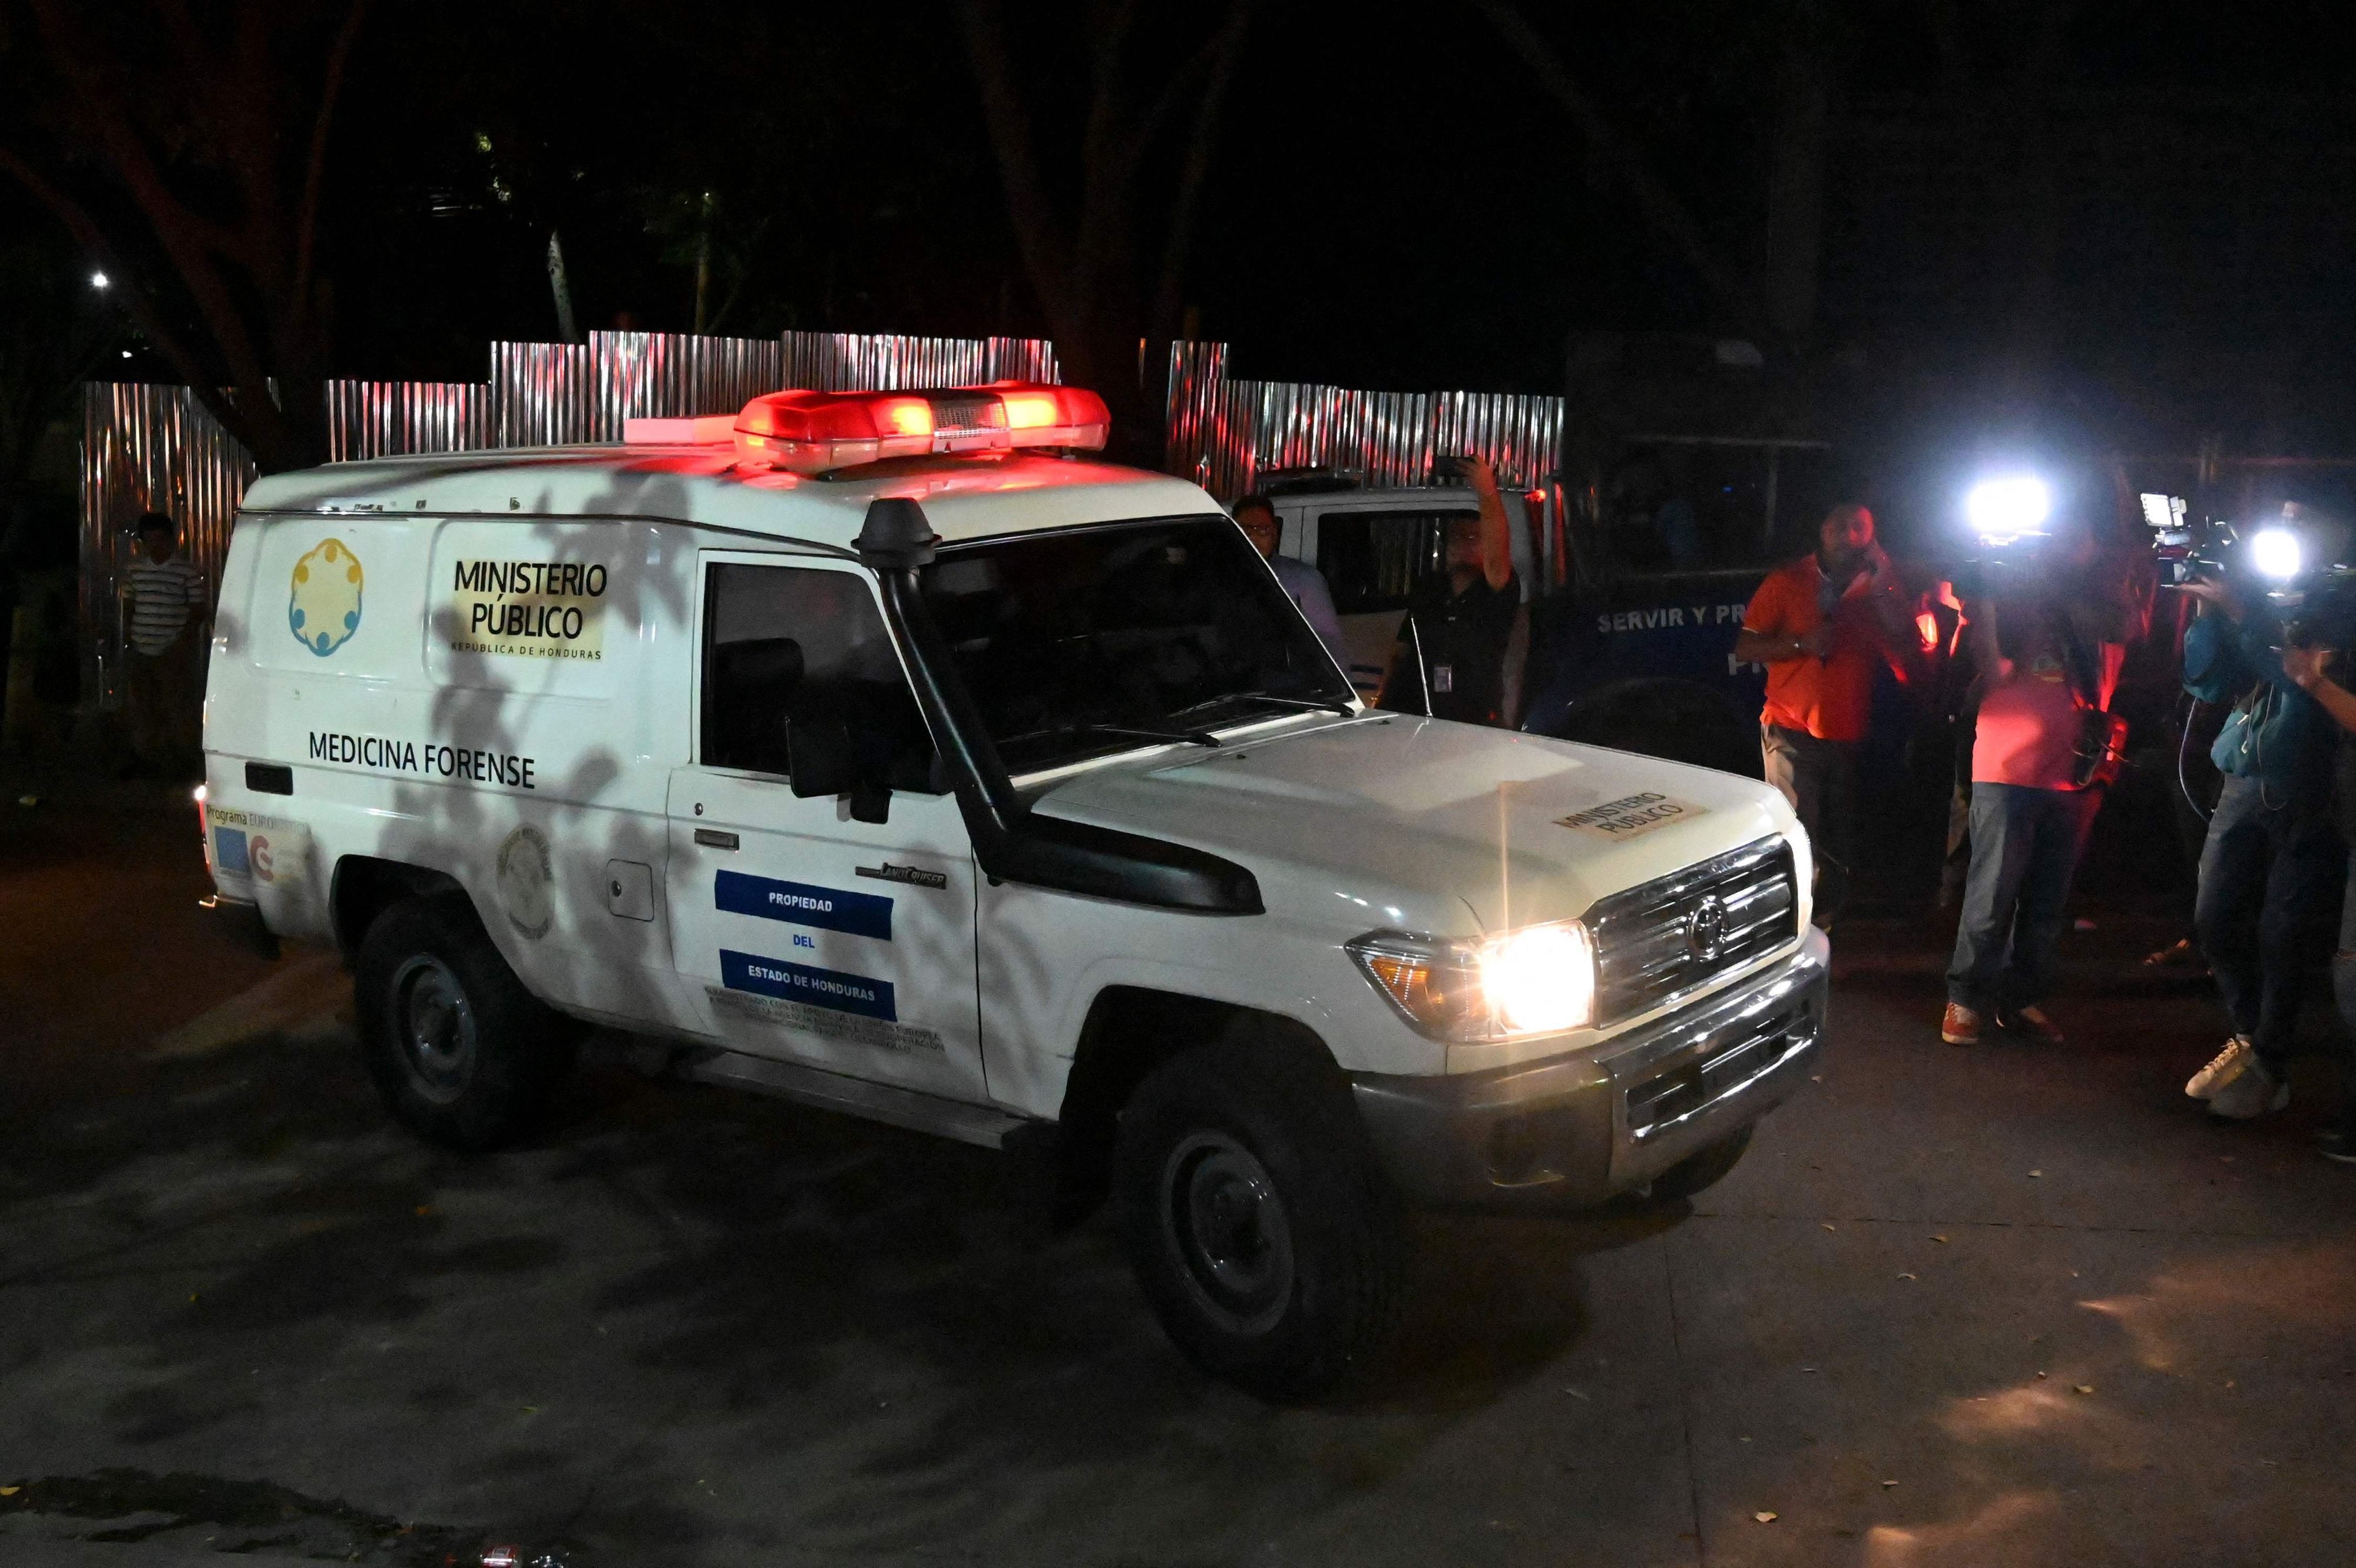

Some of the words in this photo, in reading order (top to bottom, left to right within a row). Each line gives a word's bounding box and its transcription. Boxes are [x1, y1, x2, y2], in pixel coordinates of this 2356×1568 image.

[454, 561, 607, 597] MINISTERIO
[472, 593, 583, 640] PÚBLICO
[1597, 608, 1684, 633] SERVIR
[1692, 607, 1707, 625] Y
[452, 641, 514, 654] REPÚBLICA
[519, 646, 534, 655] DE
[540, 648, 601, 660] HONDURAS
[309, 732, 417, 772] MEDICINA
[425, 745, 535, 790] FORENSE
[206, 804, 247, 825] Programa
[1552, 792, 1666, 828] MINISTERIO
[769, 892, 832, 913] PROPIEDAD
[793, 934, 815, 950] DEL
[748, 965, 790, 984] ESTADO
[793, 973, 809, 988] DE
[812, 978, 875, 1001] HONDURAS
